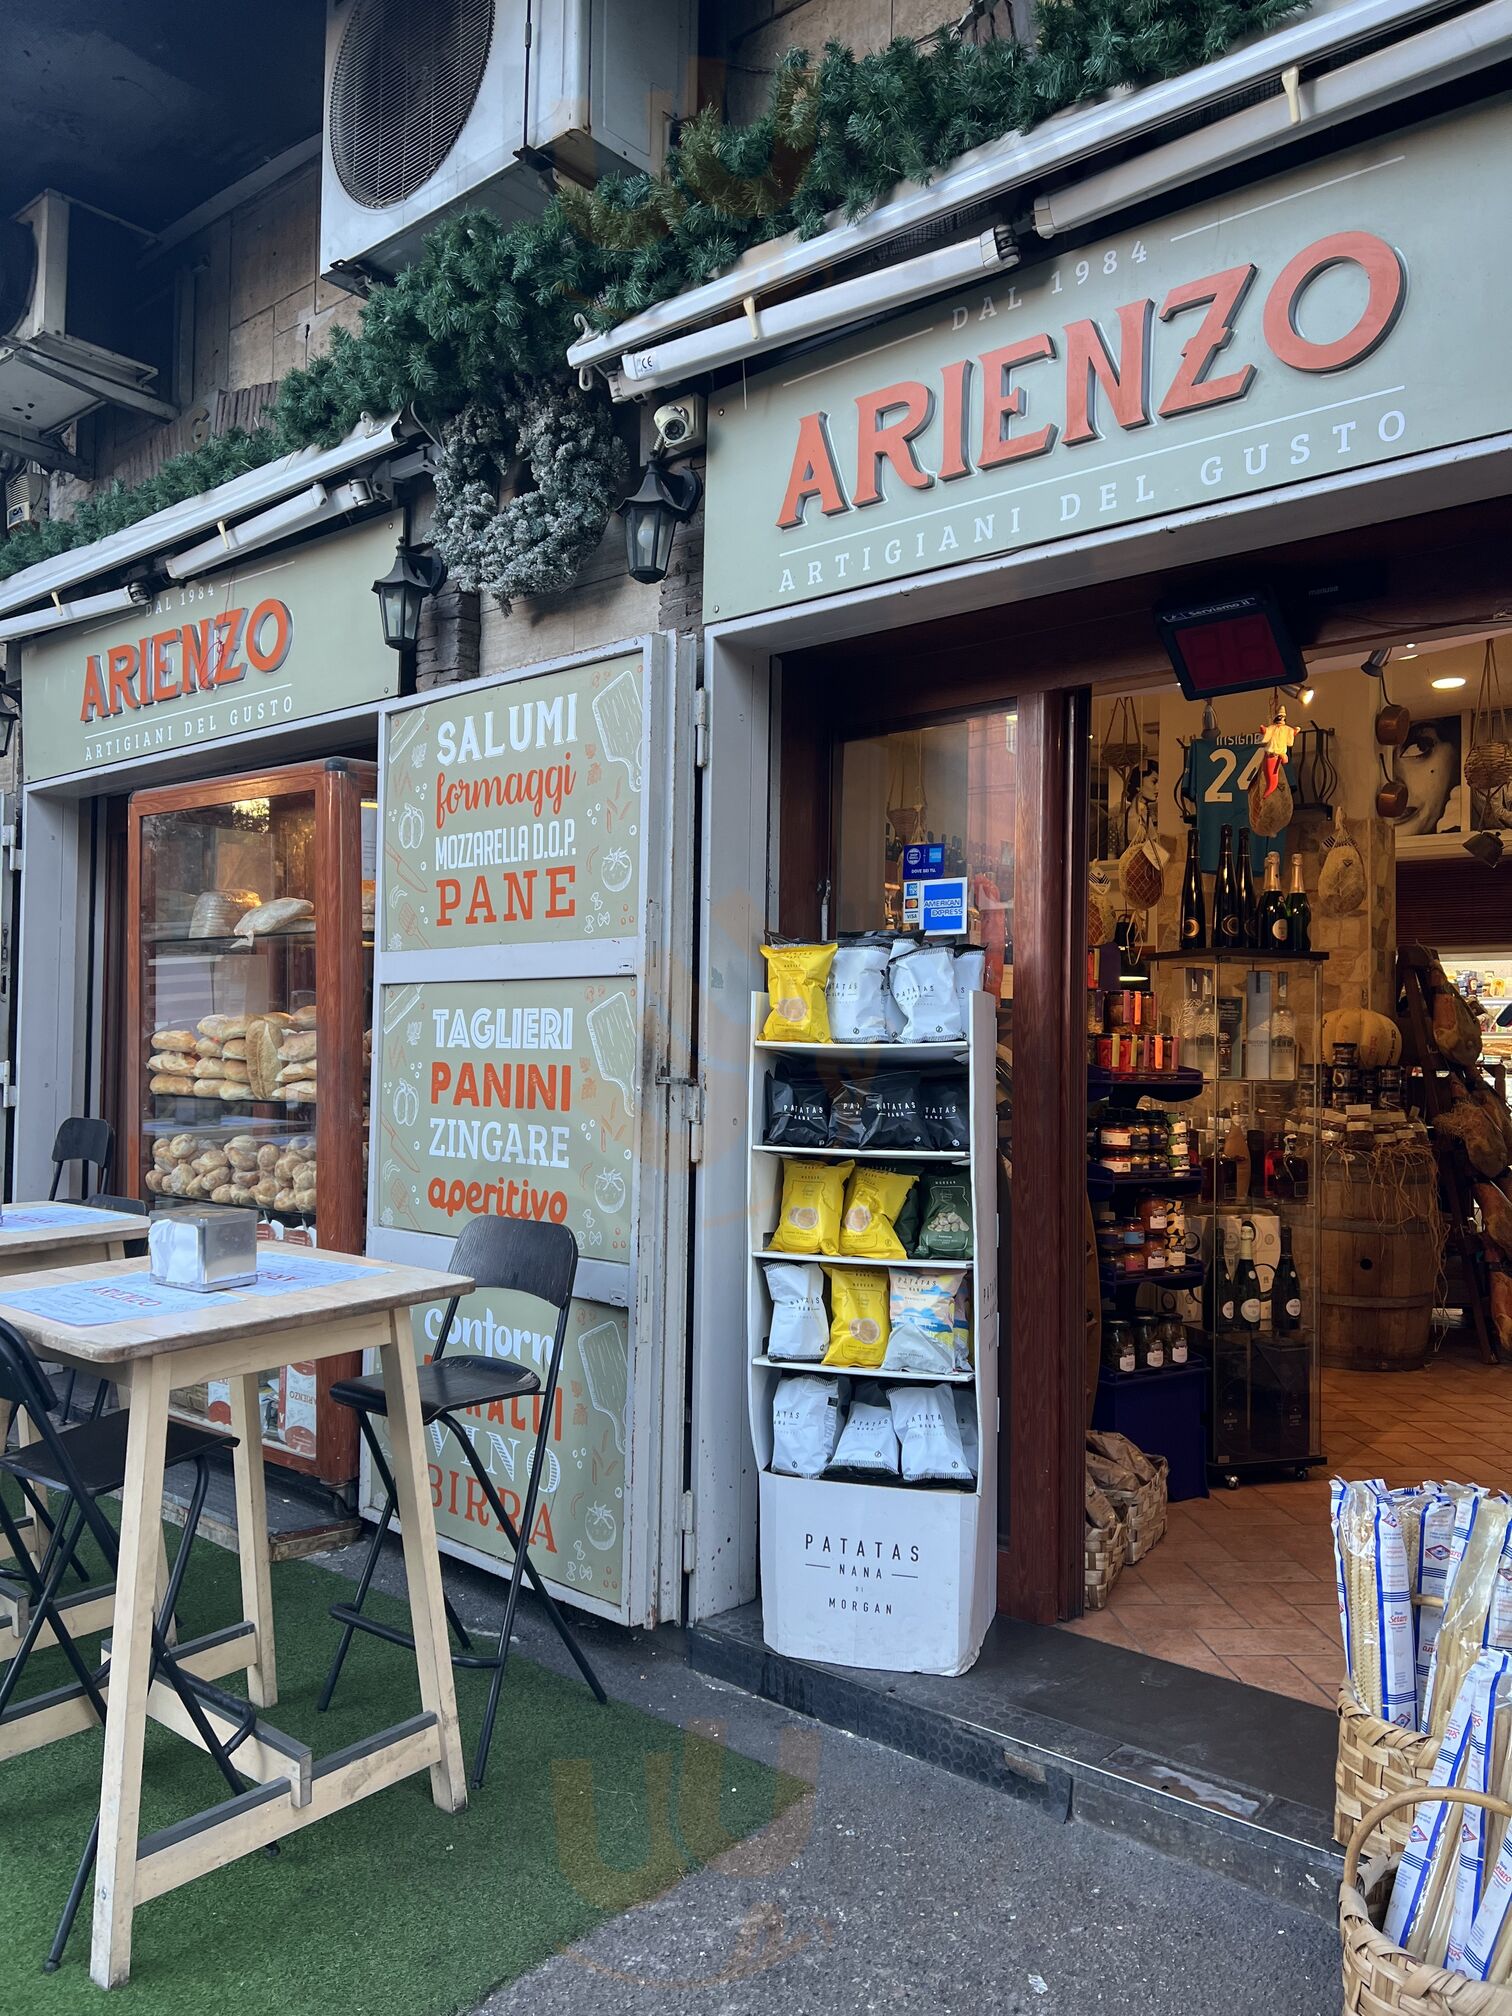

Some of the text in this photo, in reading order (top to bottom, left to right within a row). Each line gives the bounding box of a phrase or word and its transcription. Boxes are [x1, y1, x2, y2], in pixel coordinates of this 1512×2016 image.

[952, 241, 1148, 331] DAL 1984
[642, 356, 653, 369] CE
[776, 231, 1406, 529] ARIENZO
[779, 411, 1407, 592] ARTIGIANI DEL GUSTO
[145, 583, 214, 618] DAL 1984
[81, 598, 293, 722] ARIENZO
[85, 696, 293, 762] ARTIGIANI DEL GUSTO
[437, 693, 578, 766] SALUMI
[436, 752, 577, 829] formaggi
[436, 819, 576, 871] MOZZARELLA D.O.P.
[436, 866, 576, 926] PANE
[924, 899, 960, 907] AMERICAN
[932, 909, 963, 917] EXPRESS
[433, 1008, 574, 1050] TAGLIERI
[431, 1061, 571, 1111] PANINI
[784, 1104, 823, 1114] PATATAS
[925, 1105, 956, 1114] TATAS
[429, 1118, 570, 1168] ZINGARE
[428, 1177, 568, 1225] aperitivo
[424, 1307, 563, 1371] contorn
[776, 1410, 799, 1419] ATAS
[429, 1419, 561, 1493] VINO
[428, 1463, 558, 1553] BIRRA
[805, 1533, 919, 1562] PATATAS
[839, 1563, 882, 1579] NANA
[829, 1597, 892, 1615] MORGAN
